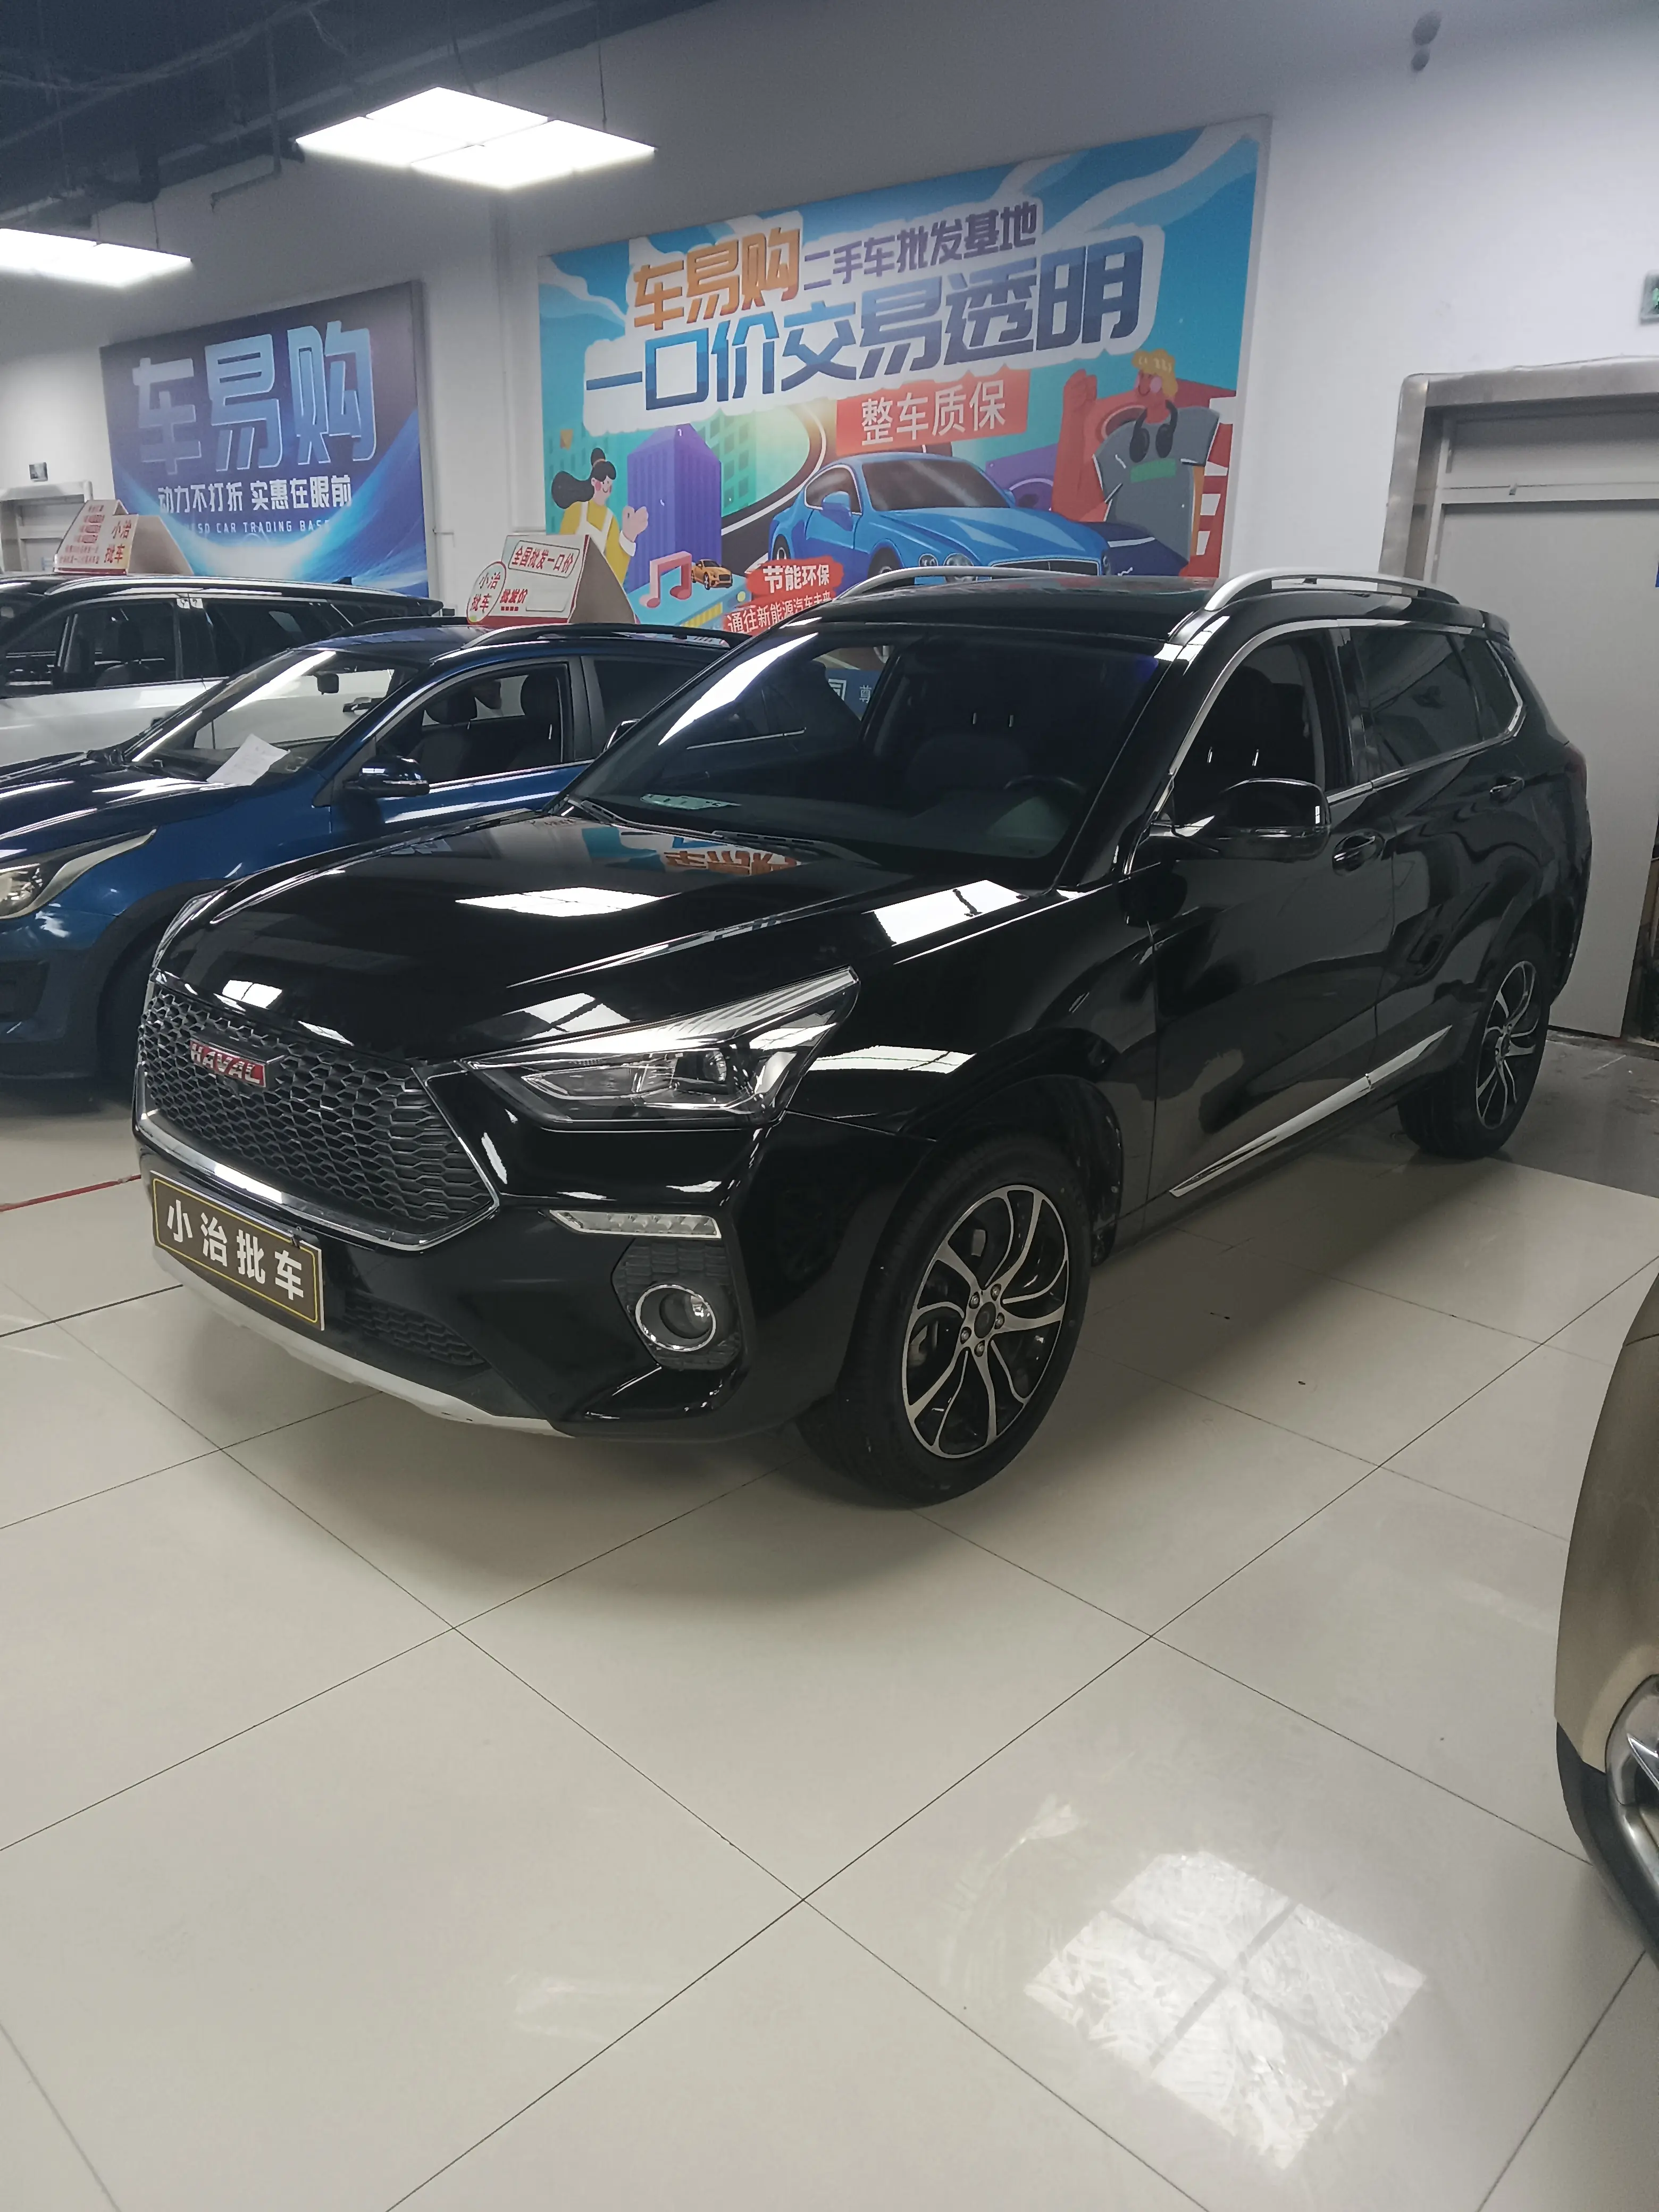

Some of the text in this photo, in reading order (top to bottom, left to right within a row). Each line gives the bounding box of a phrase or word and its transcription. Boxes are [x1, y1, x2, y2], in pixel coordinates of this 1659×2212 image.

[633, 227, 800, 330] 车易购
[803, 202, 1037, 290] 二手车批发基地
[585, 234, 1144, 410] 一口价交易透明
[132, 320, 377, 475] 车易购
[861, 380, 1006, 446] 整车质保
[158, 474, 352, 513] 动力不打折 实惠在眼前
[216, 523, 236, 533] CAR
[243, 521, 292, 533] TRADING
[763, 564, 830, 593] 节能环保
[190, 1043, 260, 1084] HAVAL
[167, 1200, 304, 1300] 小治批车
